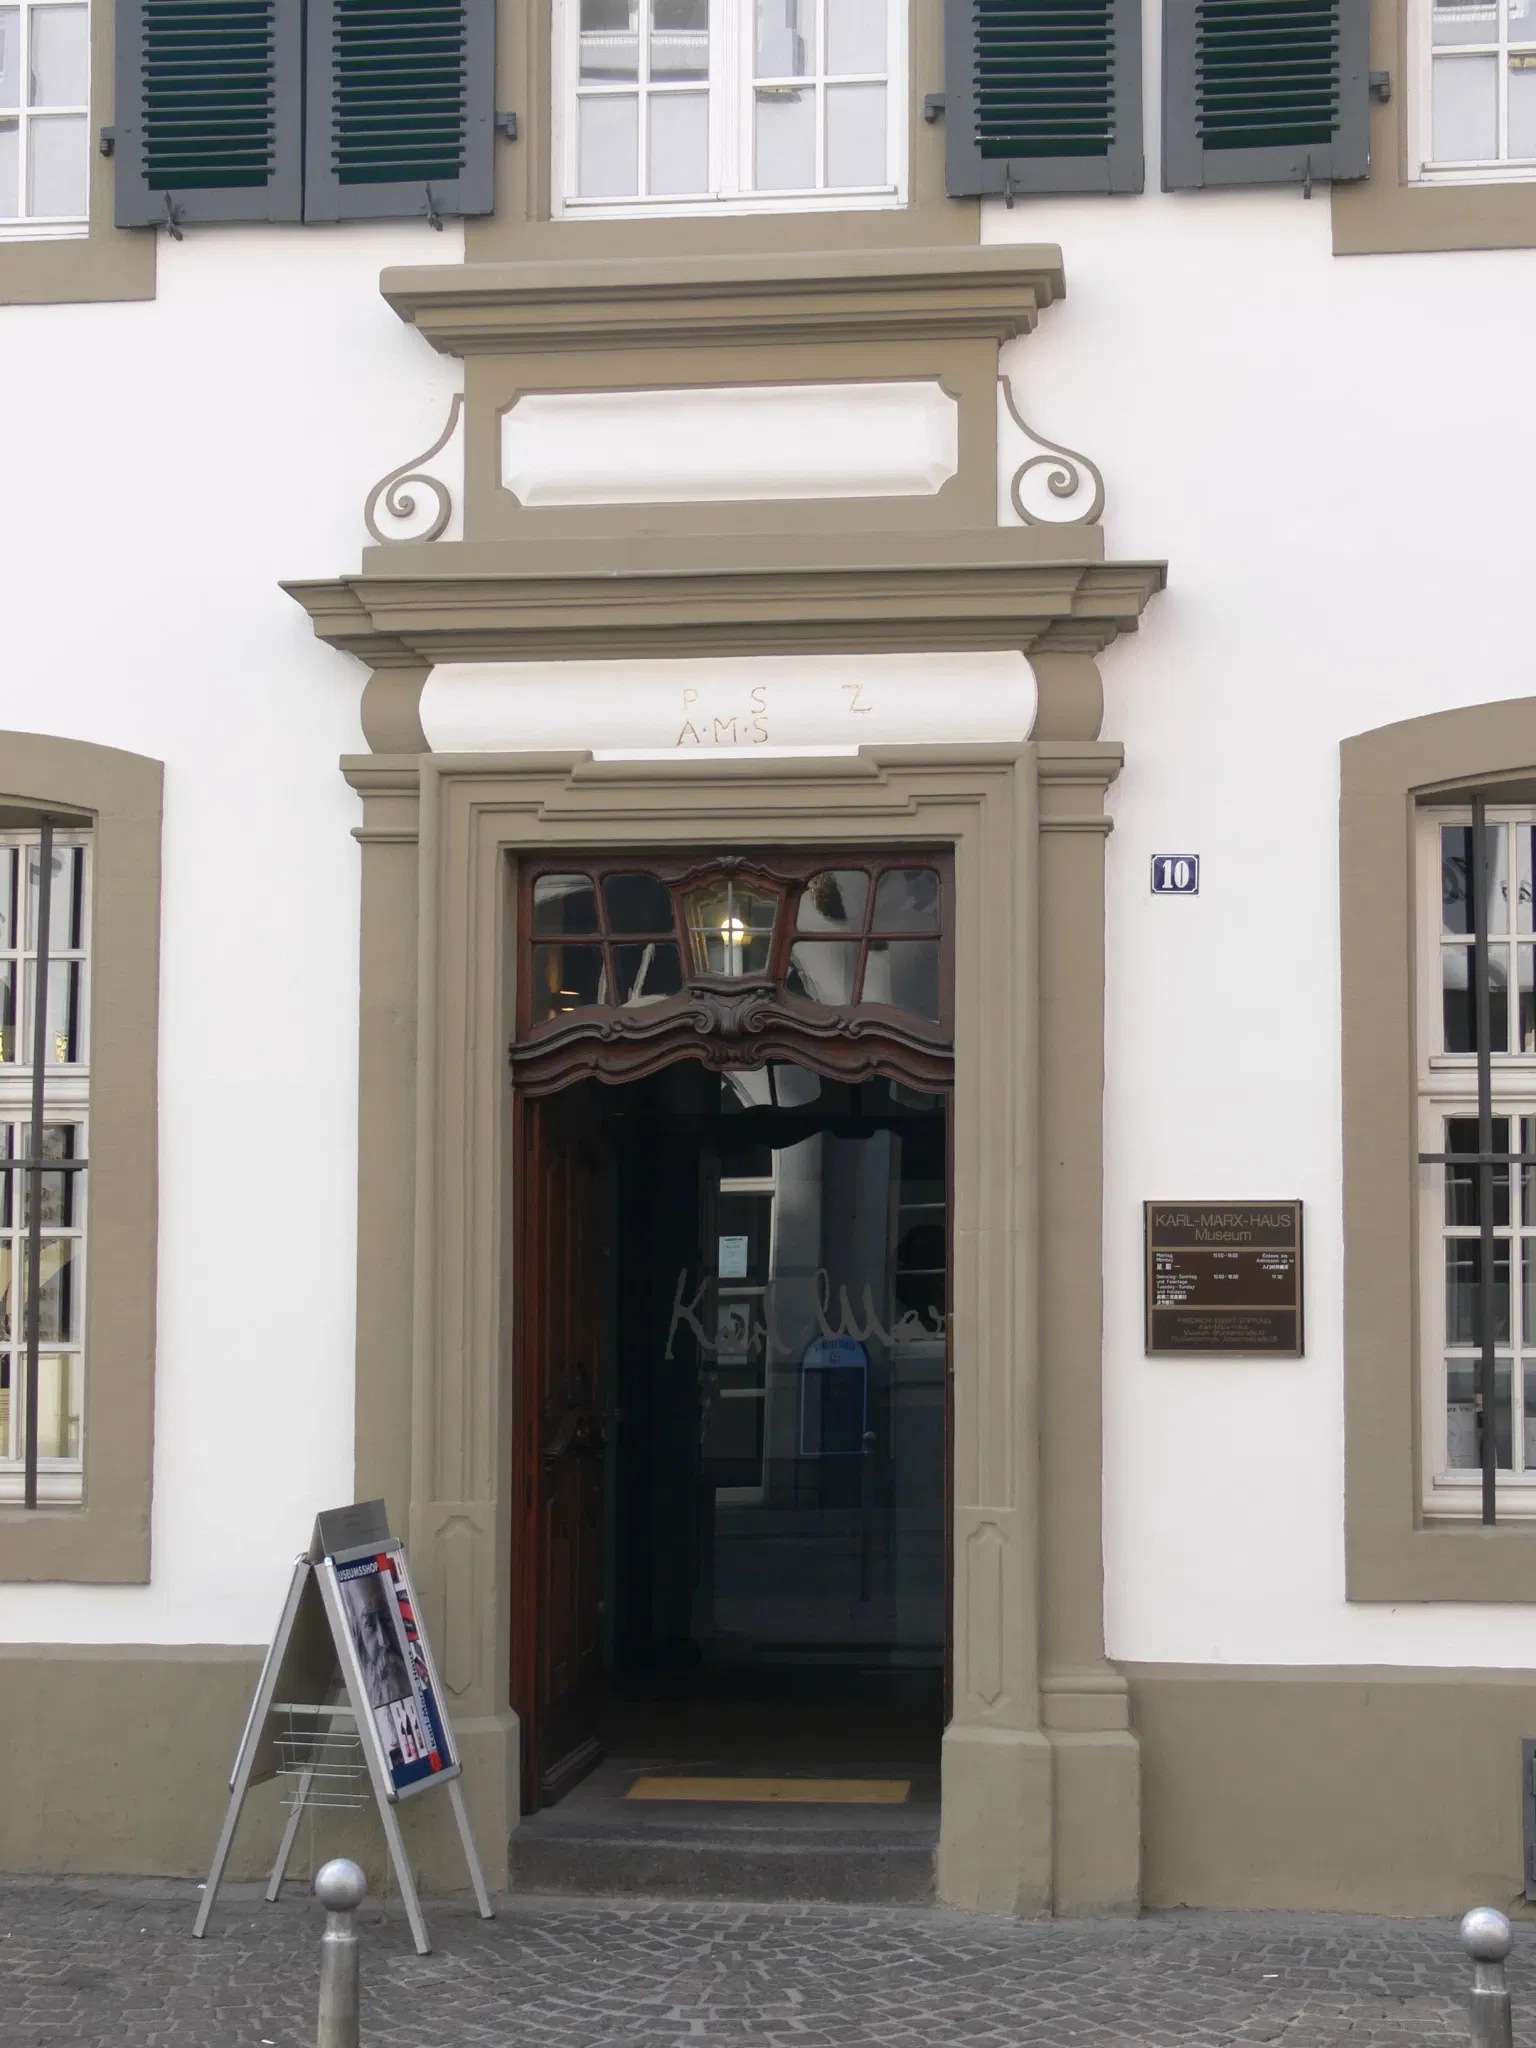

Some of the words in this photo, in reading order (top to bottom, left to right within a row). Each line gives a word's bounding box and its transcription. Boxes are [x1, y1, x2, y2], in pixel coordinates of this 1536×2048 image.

[683, 688, 698, 711] P
[751, 686, 767, 714] S
[841, 684, 872, 713] Z
[1162, 859, 1190, 889] 10
[1155, 1214, 1291, 1227] KARL-MARX-HAUS
[1195, 1229, 1252, 1241] Museum
